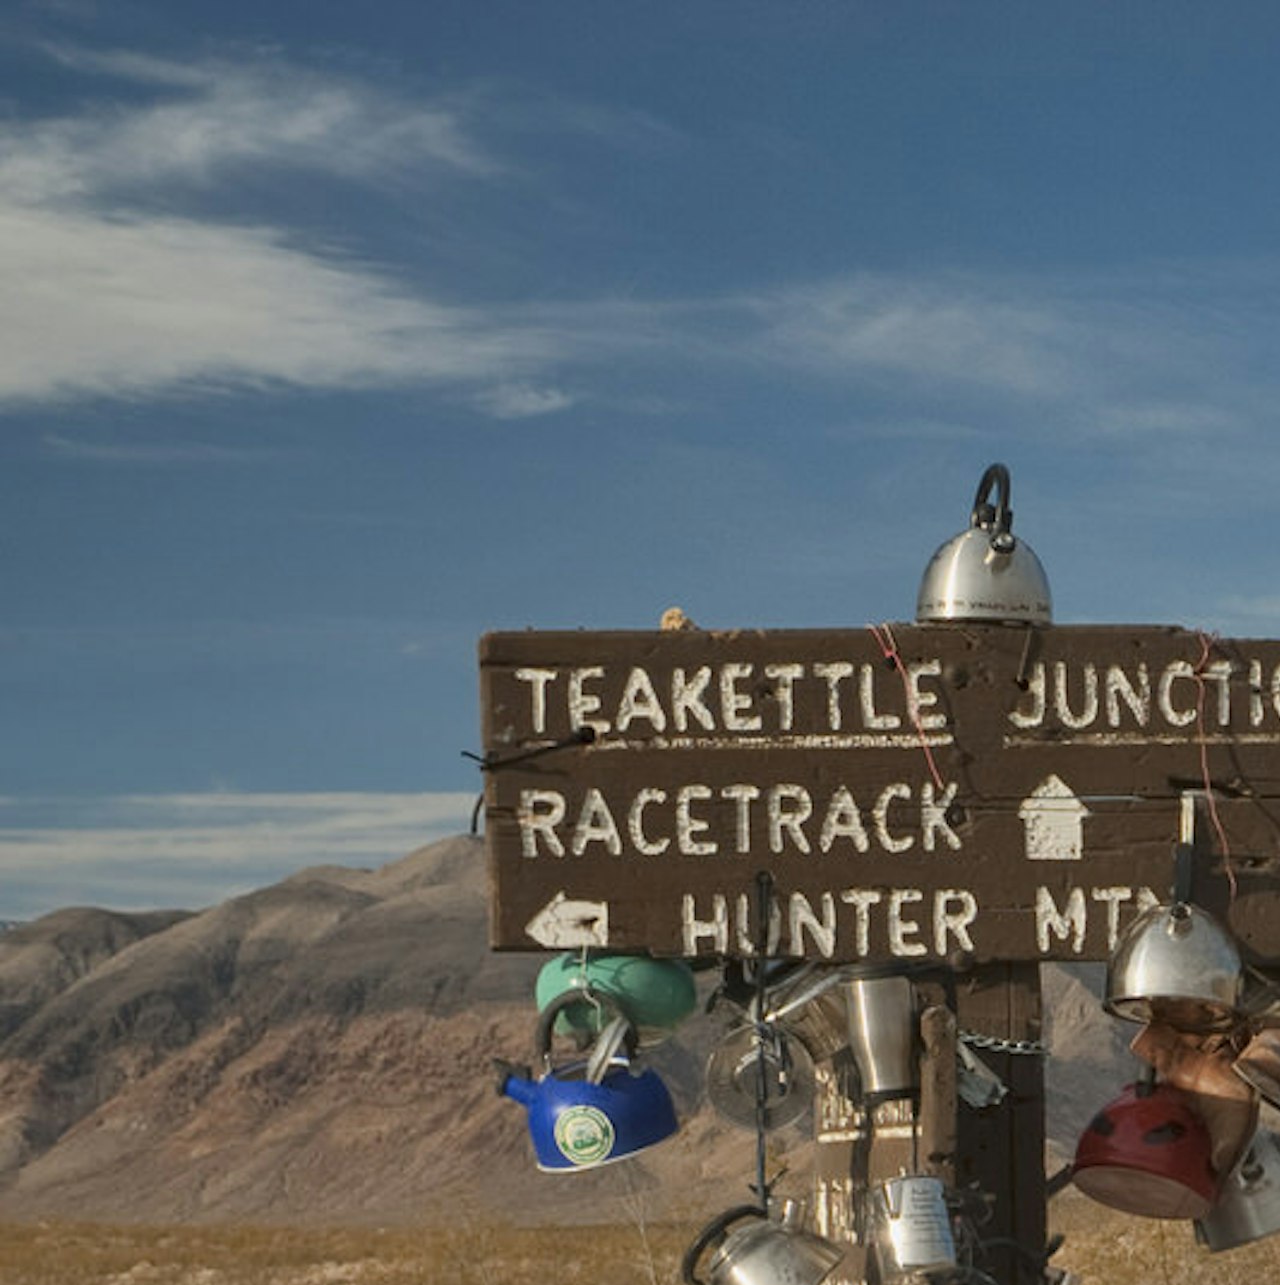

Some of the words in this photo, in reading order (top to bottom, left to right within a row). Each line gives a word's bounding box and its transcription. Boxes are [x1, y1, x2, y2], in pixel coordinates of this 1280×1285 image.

[515, 659, 947, 733] TEAKETTLE
[519, 783, 963, 858] RACETRACK
[682, 888, 979, 957] HUNTER
